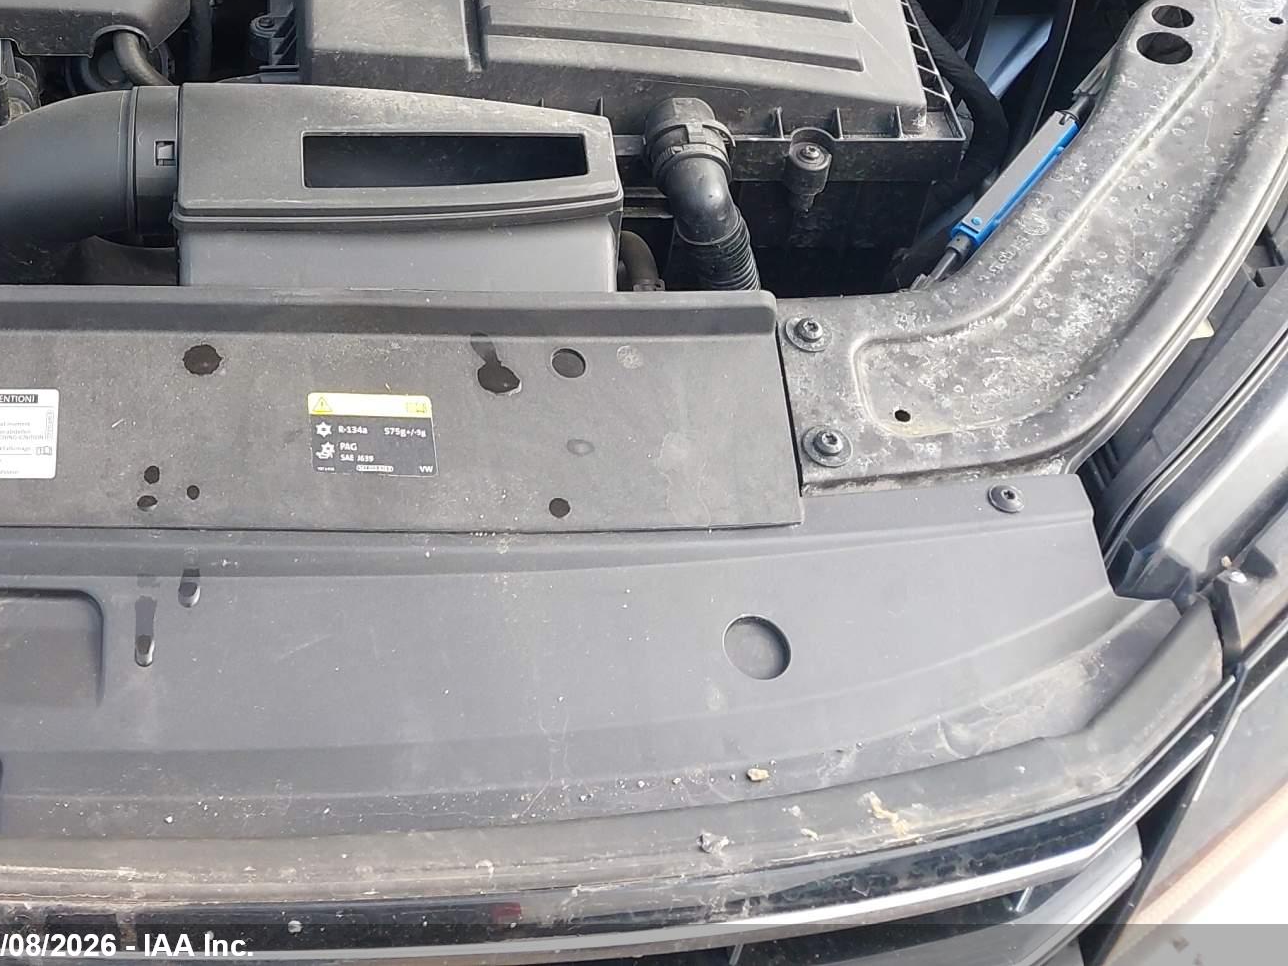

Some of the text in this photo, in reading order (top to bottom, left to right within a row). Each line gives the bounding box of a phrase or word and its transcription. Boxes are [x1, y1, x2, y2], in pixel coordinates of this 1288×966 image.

[338, 425, 368, 434] R-134a
[339, 442, 358, 451] PAG
[340, 454, 354, 462] SAE
[419, 465, 433, 473] VW
